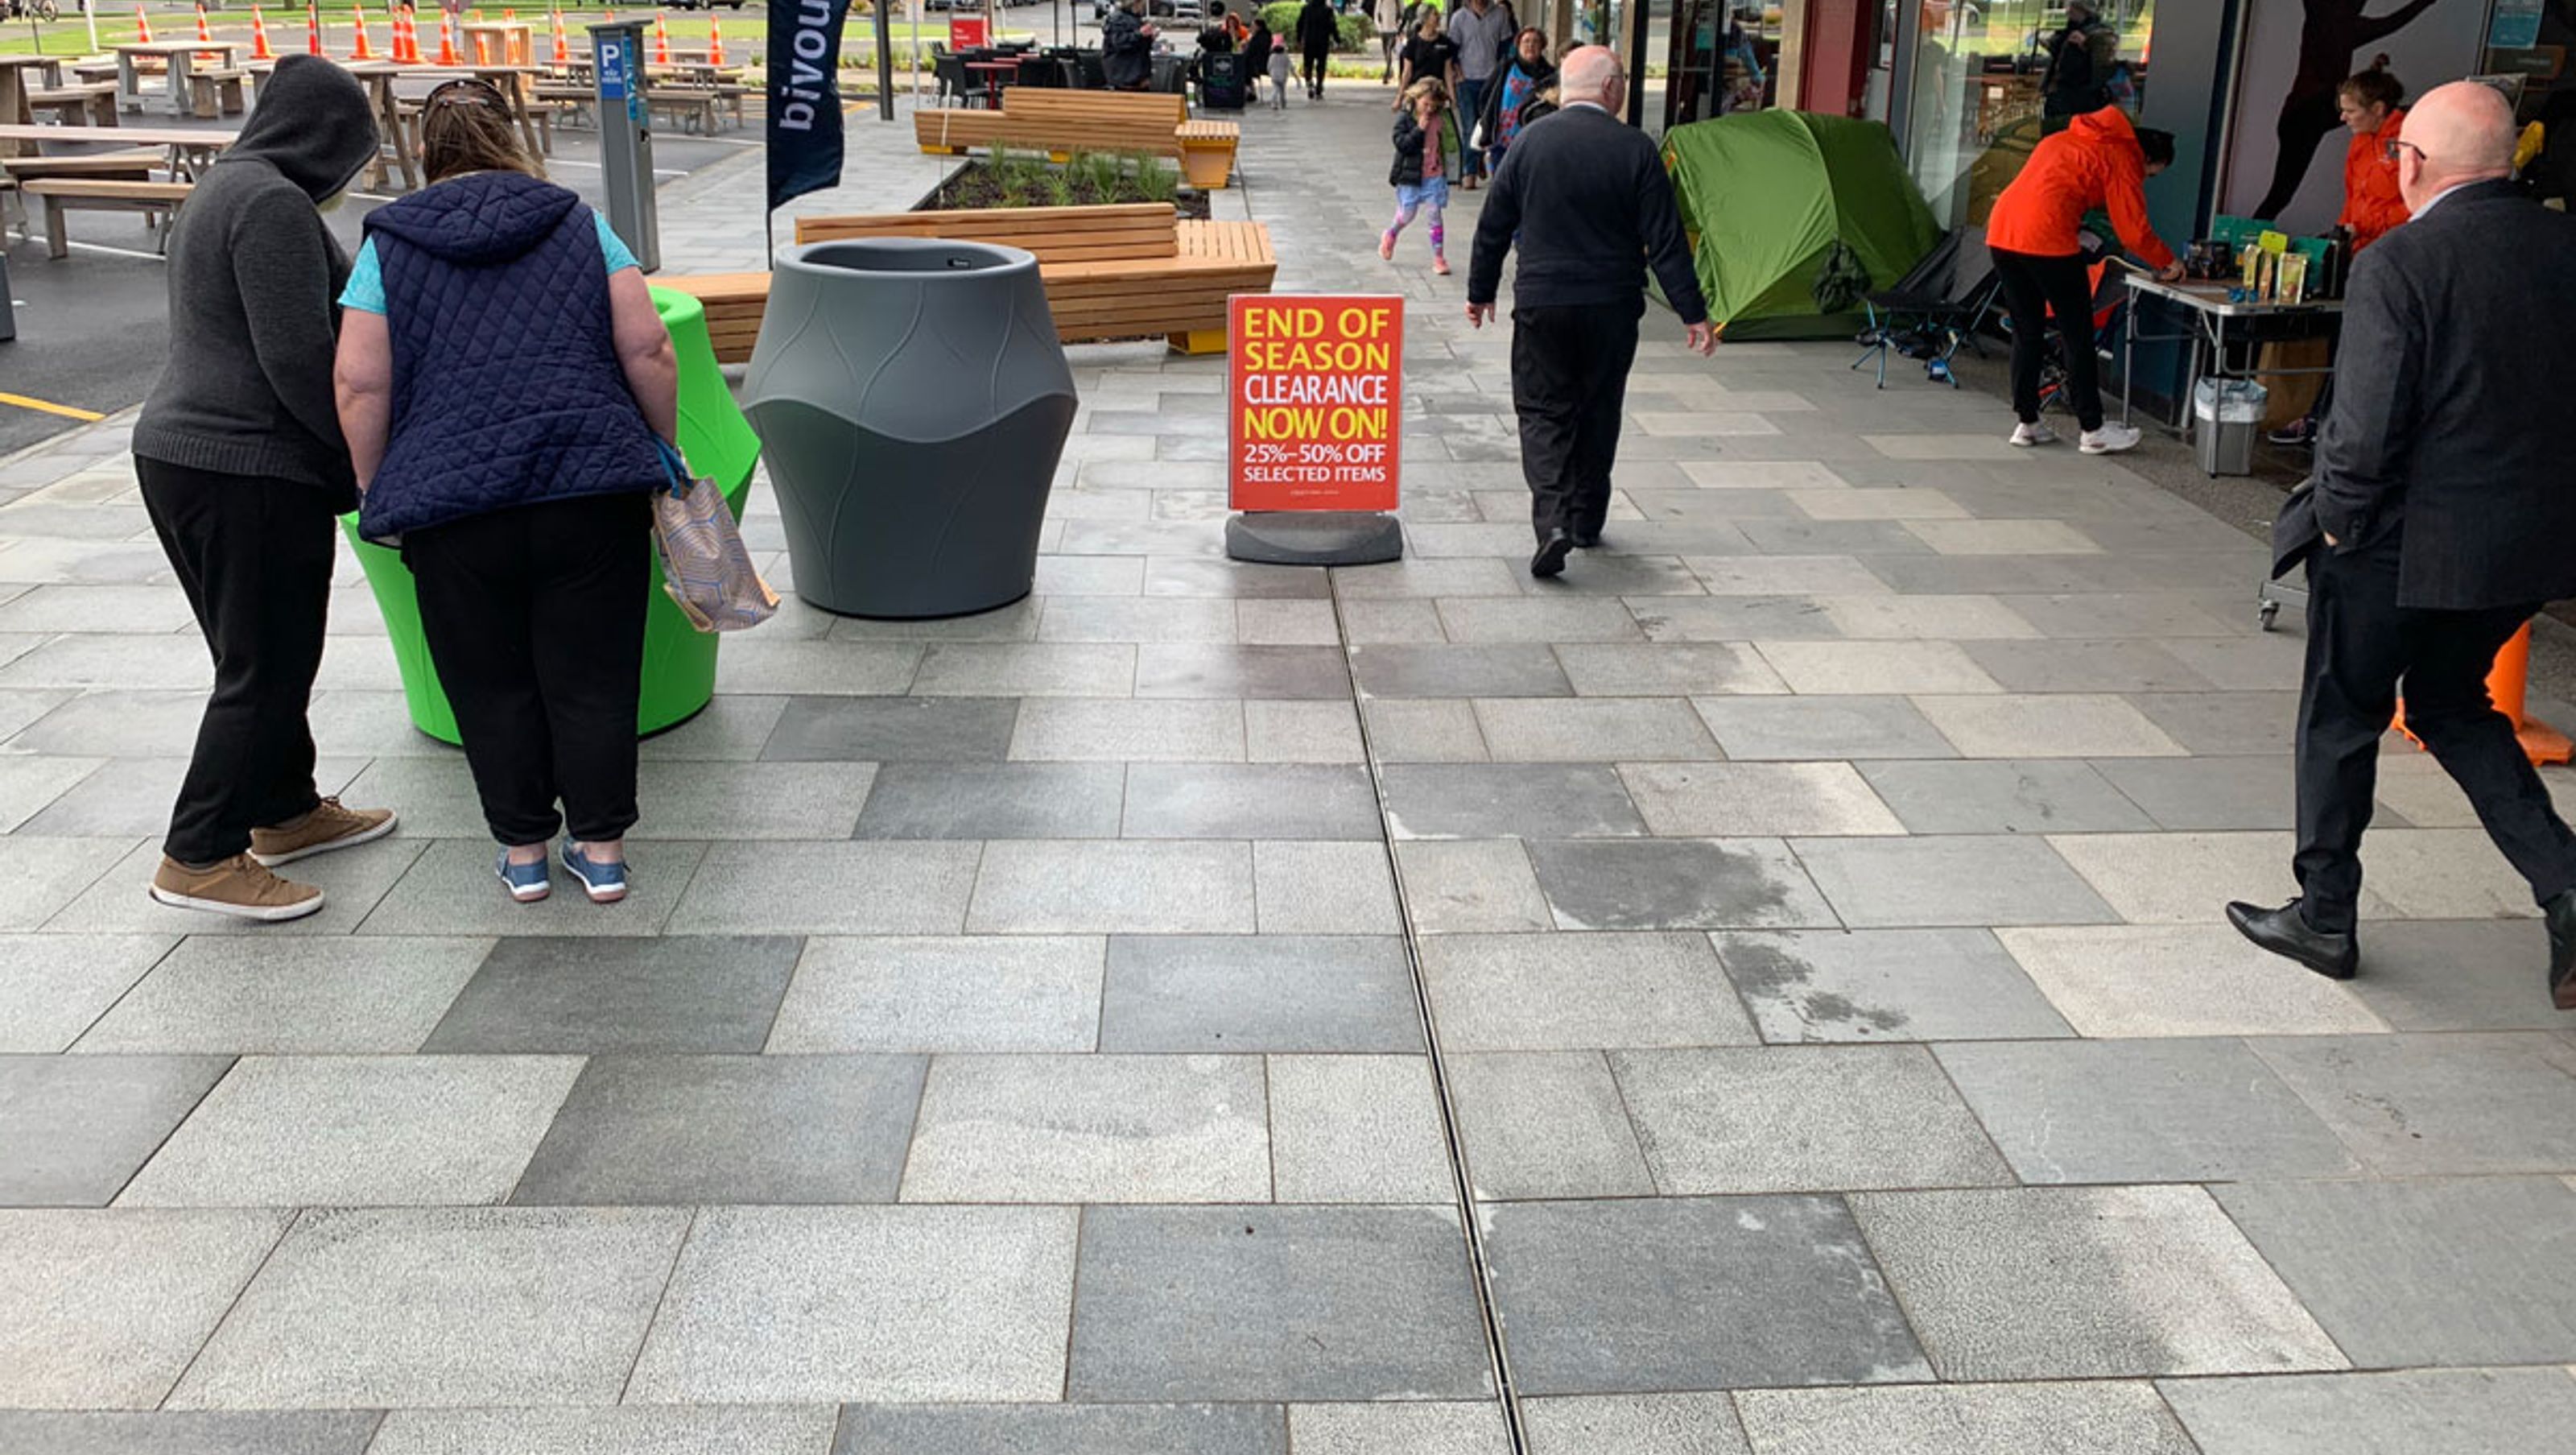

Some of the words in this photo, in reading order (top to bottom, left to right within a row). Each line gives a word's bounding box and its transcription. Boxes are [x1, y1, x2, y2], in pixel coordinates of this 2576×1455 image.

[601, 44, 620, 68] P
[1245, 308, 1324, 337] END
[1338, 308, 1390, 338] OF
[1245, 341, 1389, 370] SEASON
[1245, 375, 1387, 404] CLEARANCE
[1244, 407, 1324, 439] NOW
[1330, 407, 1387, 439] ON!
[1346, 444, 1386, 463] OFF
[1244, 466, 1330, 482] SELECTED
[1335, 466, 1386, 482] ITEMS
